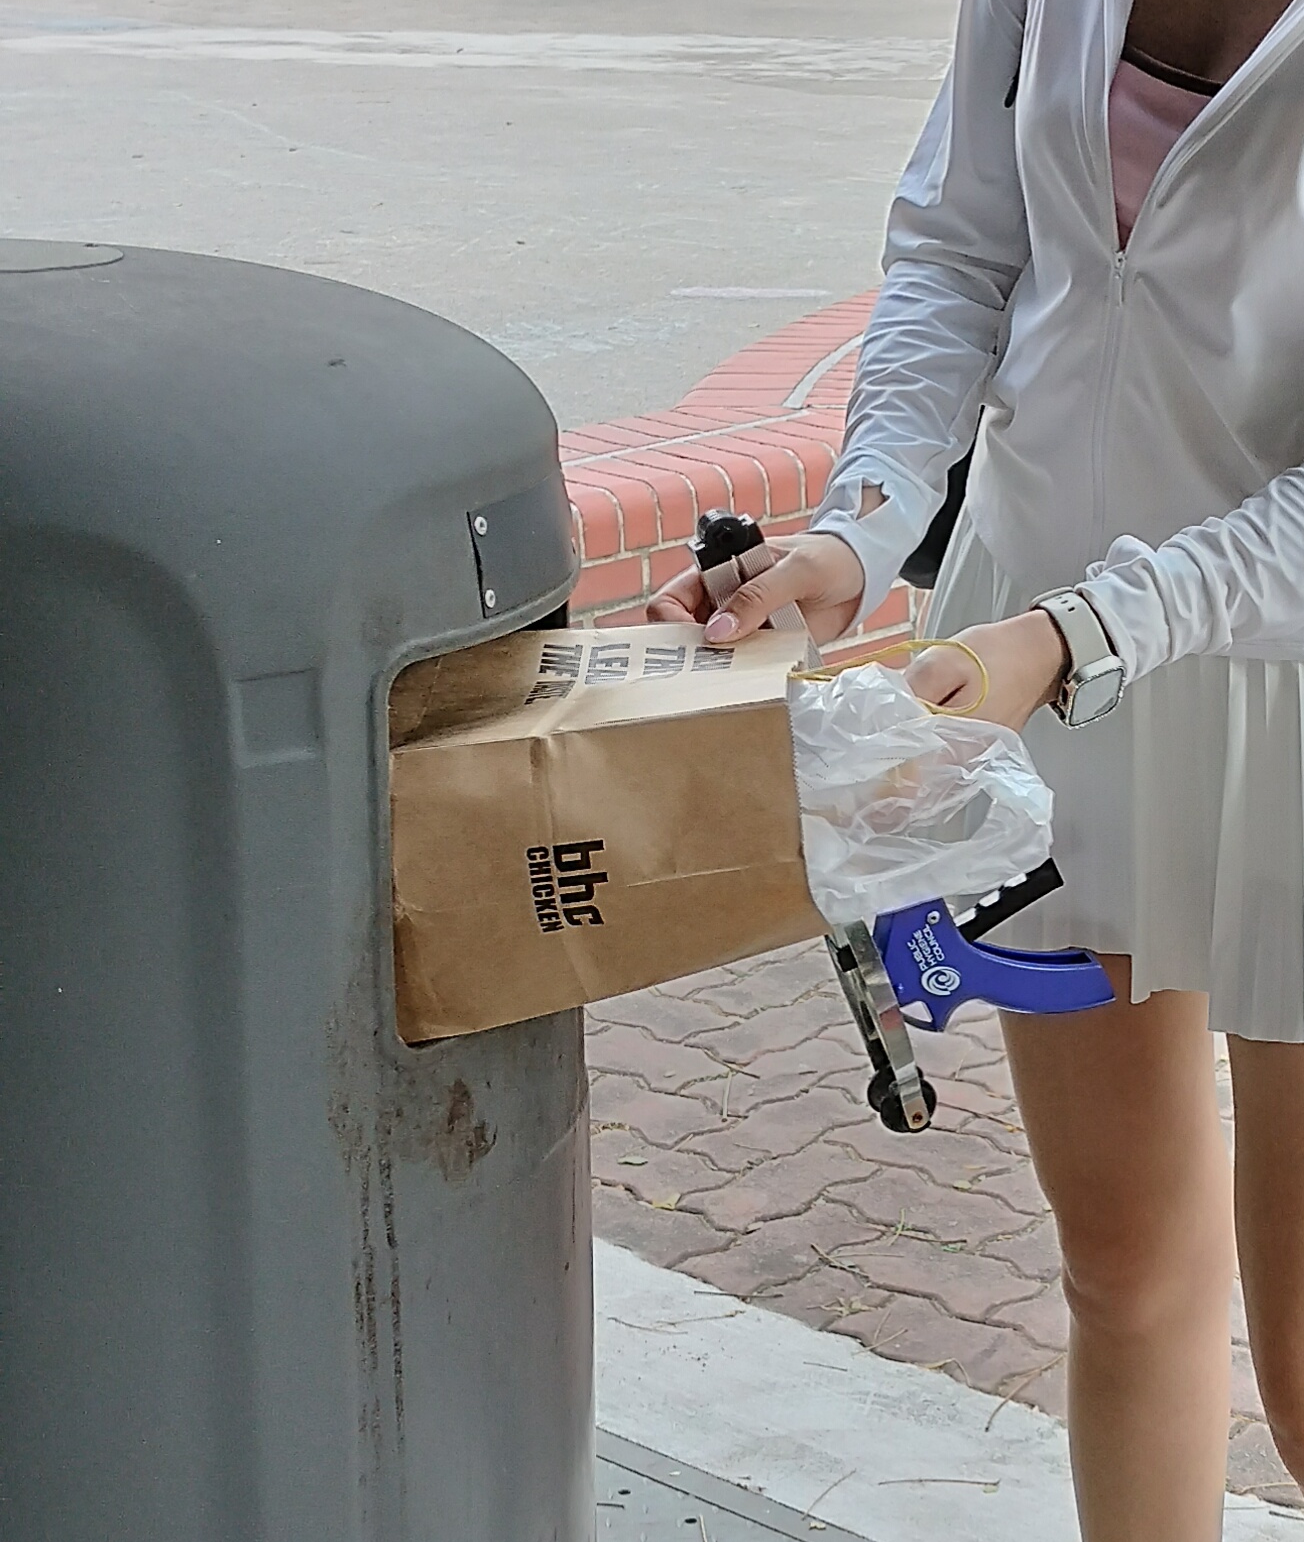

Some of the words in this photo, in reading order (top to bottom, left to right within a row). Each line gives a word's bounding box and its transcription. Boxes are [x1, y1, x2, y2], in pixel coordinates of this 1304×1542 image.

[538, 644, 583, 677] THE
[526, 846, 565, 933] CHICKEN
[552, 839, 609, 927] bhc
[906, 939, 929, 971] PUBLIC
[922, 923, 945, 962] COUNCIL
